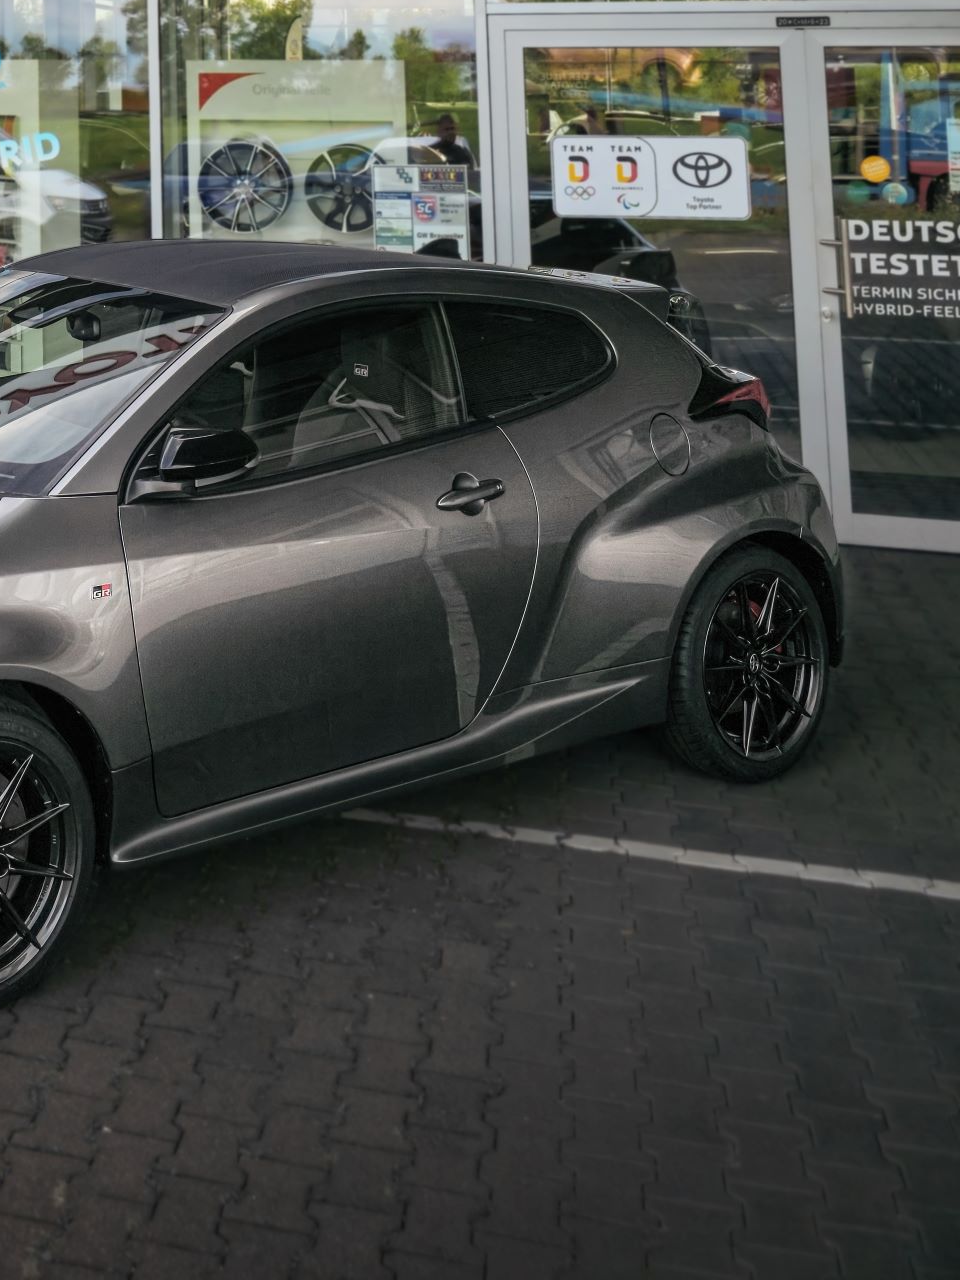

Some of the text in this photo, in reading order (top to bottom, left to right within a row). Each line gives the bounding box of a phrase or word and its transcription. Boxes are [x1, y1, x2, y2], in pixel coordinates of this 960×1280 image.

[848, 219, 960, 244] DEUTS
[852, 285, 960, 301] TERMIN SICH
[93, 589, 111, 598] GR
